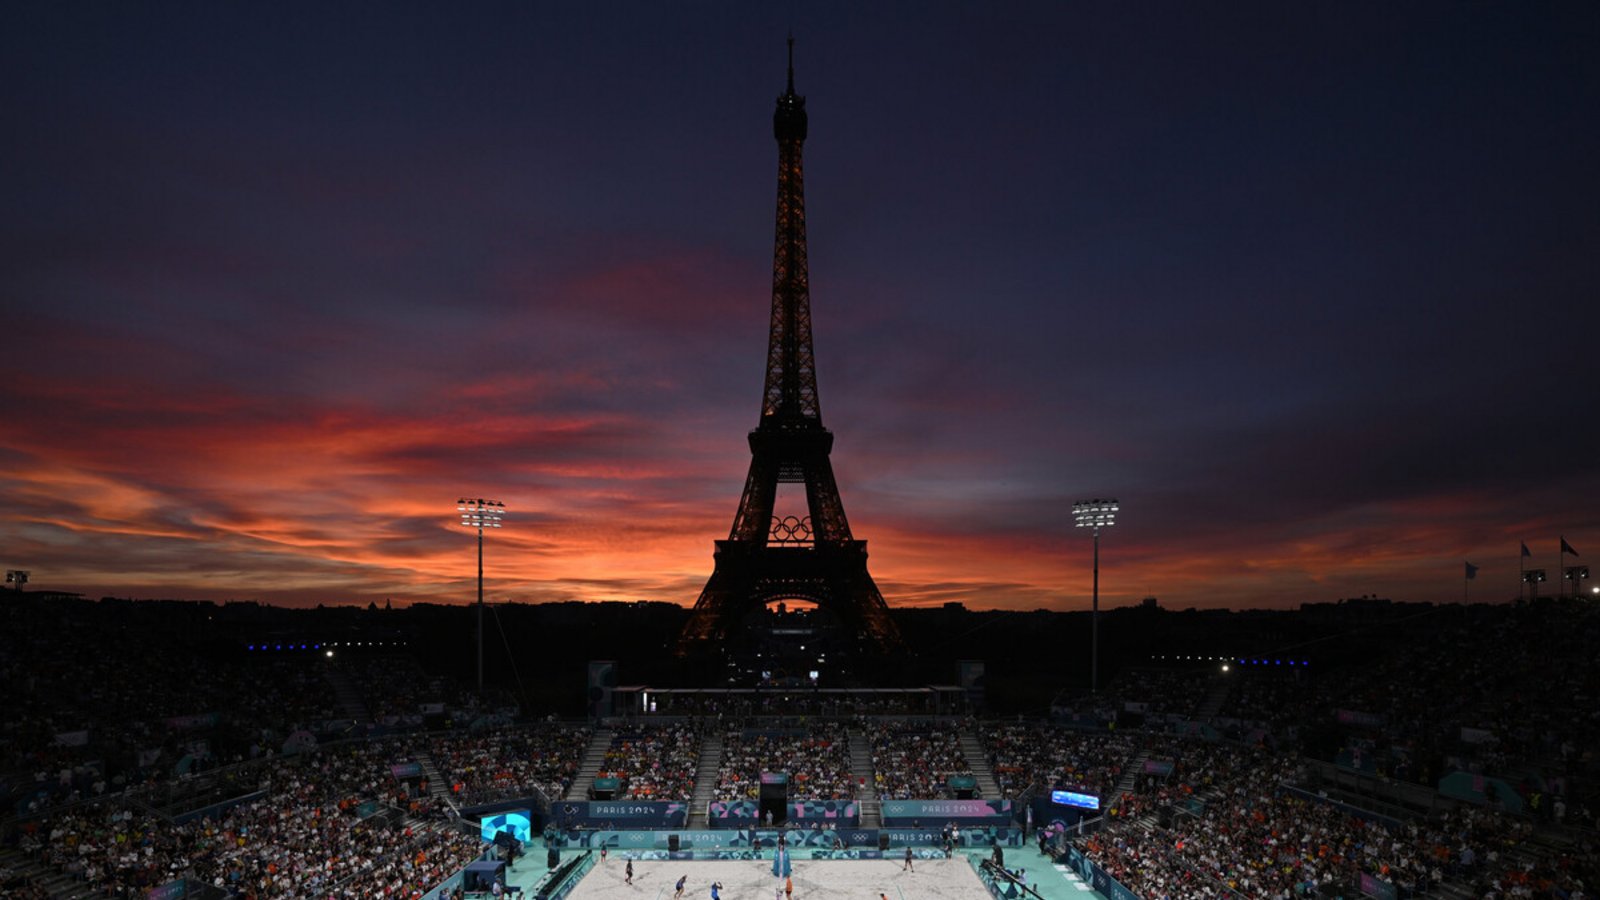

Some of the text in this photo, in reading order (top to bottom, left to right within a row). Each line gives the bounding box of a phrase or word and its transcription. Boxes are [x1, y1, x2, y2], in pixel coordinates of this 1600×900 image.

[596, 806, 656, 814] PARIS 2024
[921, 805, 980, 813] PARIS 2024
[695, 834, 722, 842] 2024
